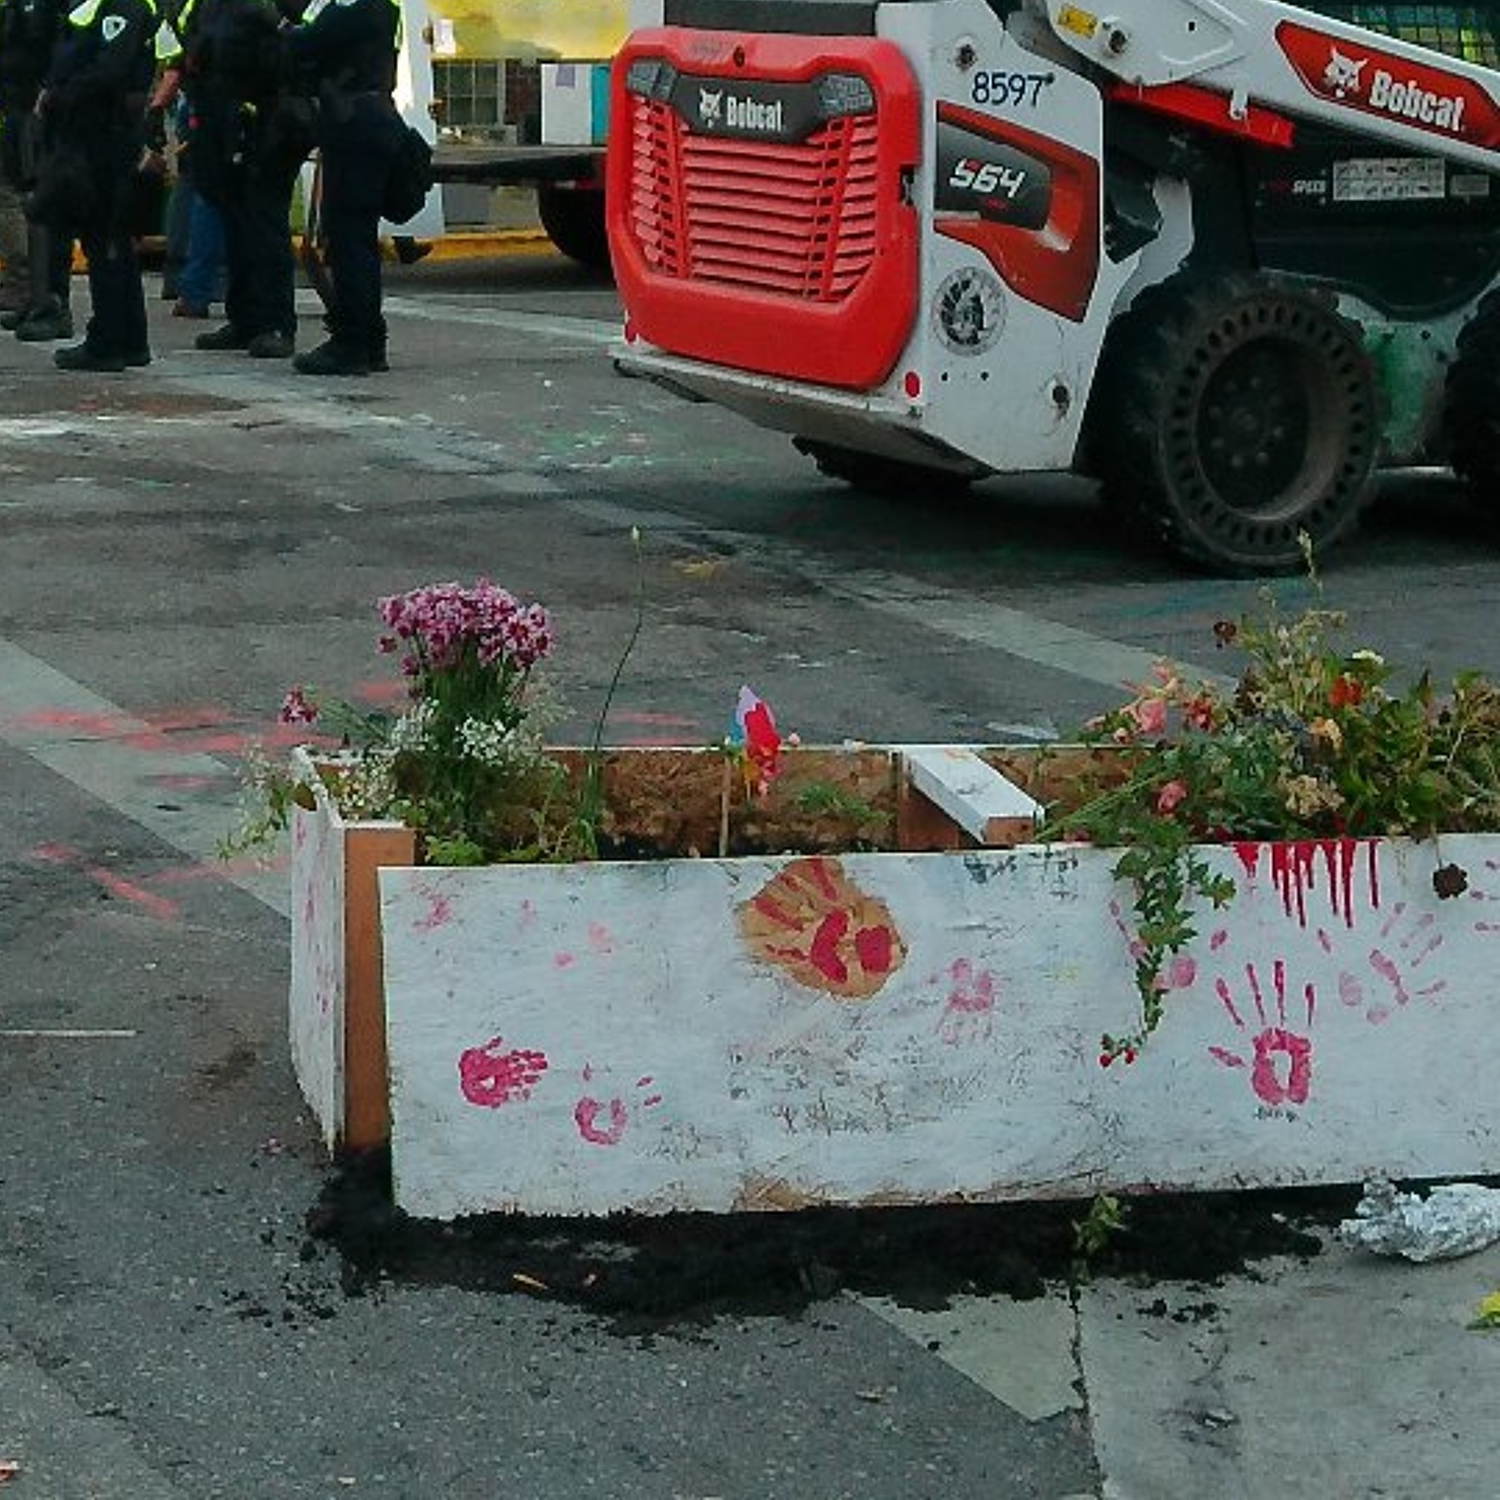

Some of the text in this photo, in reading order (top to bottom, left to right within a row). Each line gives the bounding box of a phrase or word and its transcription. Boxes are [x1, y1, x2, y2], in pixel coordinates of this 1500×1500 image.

[971, 71, 1046, 107] 8597
[1368, 69, 1466, 132] Bobcat
[726, 95, 783, 133] Bobcat
[949, 157, 1026, 198] S64
